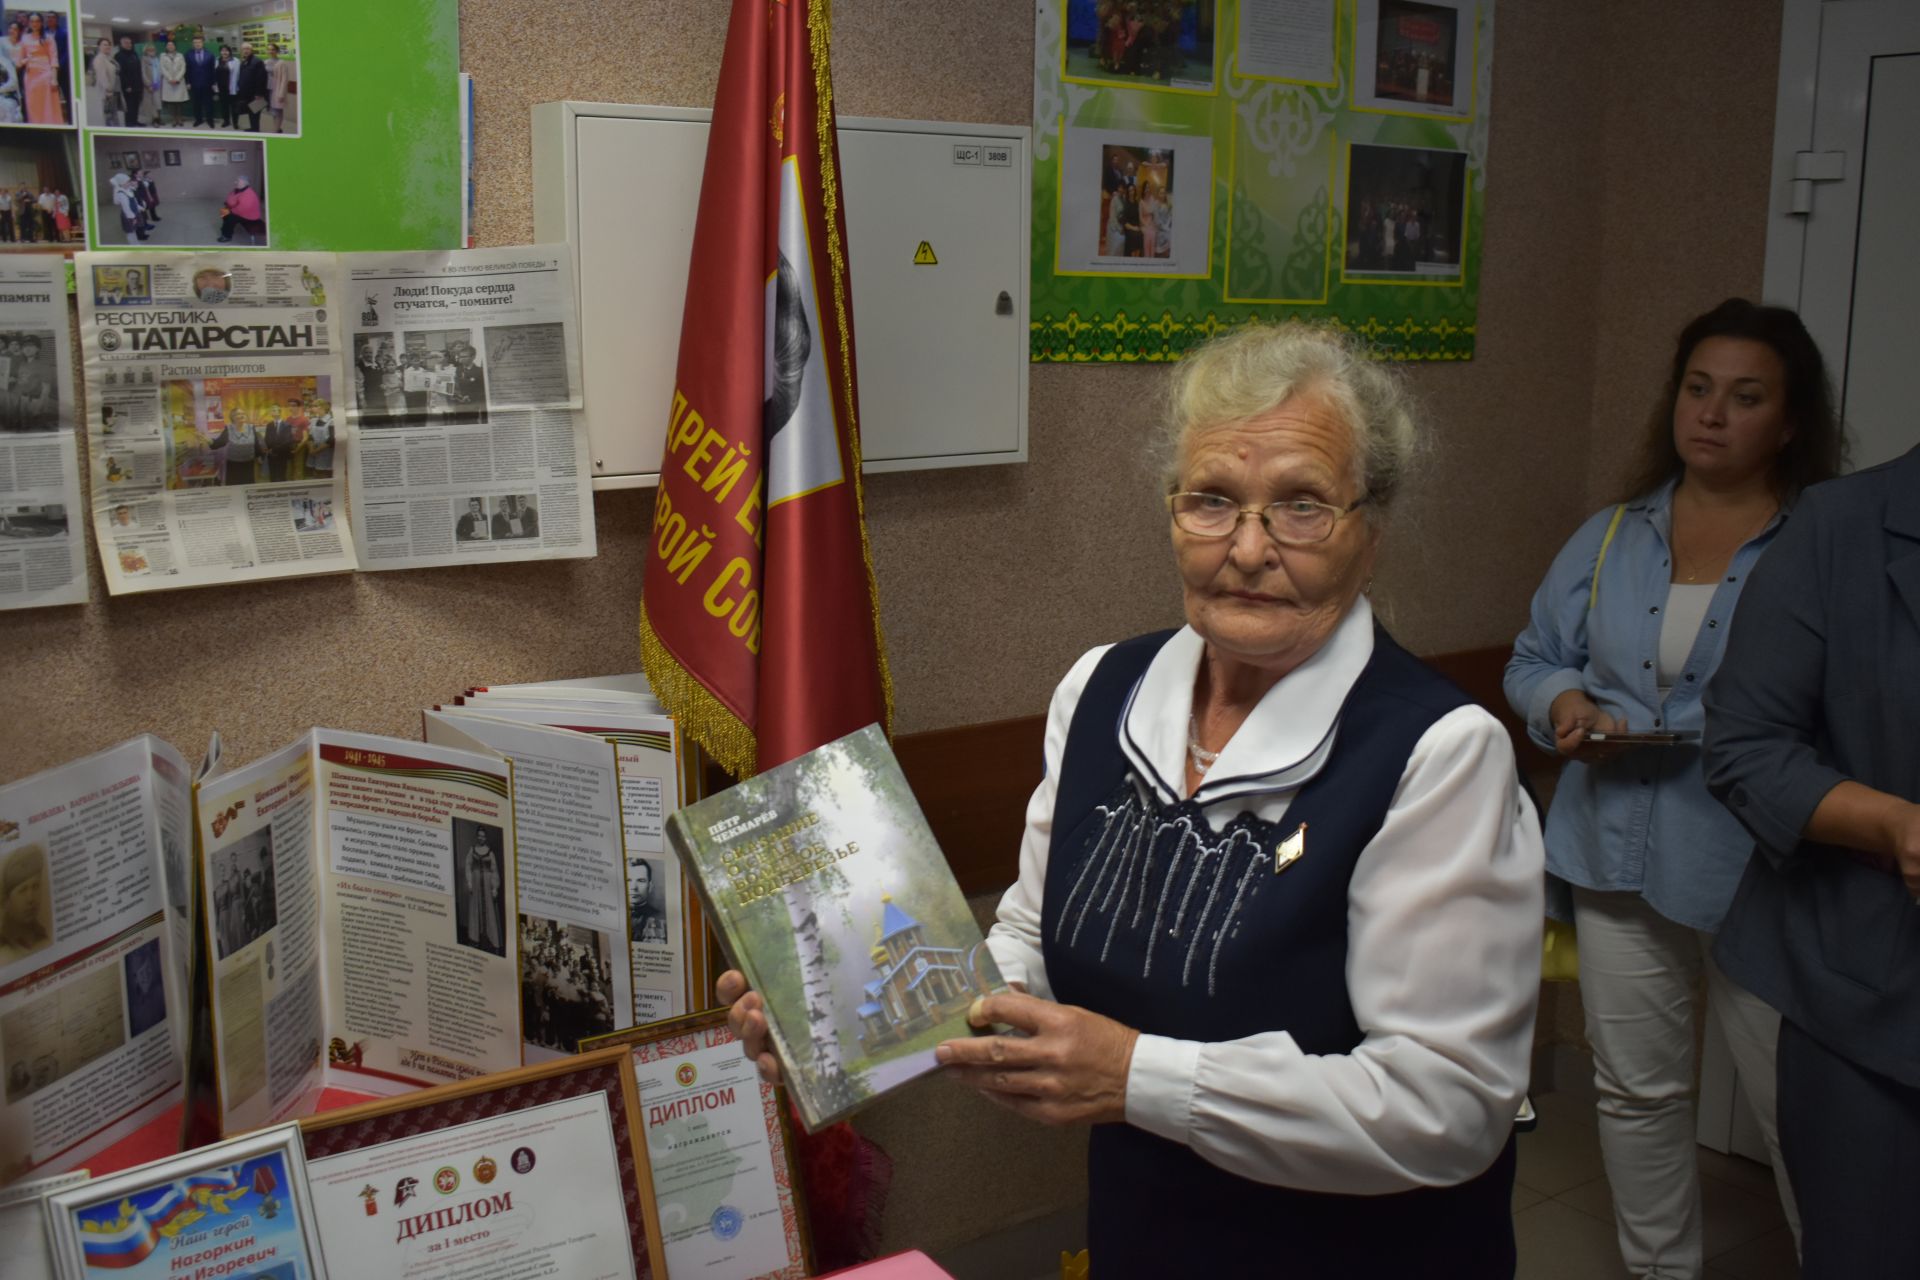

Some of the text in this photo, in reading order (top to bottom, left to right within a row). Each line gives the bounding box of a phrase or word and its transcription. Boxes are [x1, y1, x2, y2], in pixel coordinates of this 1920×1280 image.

[956, 150, 979, 160] ЩС-1
[484, 262, 517, 272] ВЕЛИКОЙ
[518, 261, 546, 269] ПОБЕДЫ
[0, 294, 50, 303] памяти
[393, 282, 515, 297] Люди! Покуда сердца
[393, 299, 449, 311] стучатся,
[459, 295, 513, 307] помните!
[95, 310, 218, 325] РЕСПУБЛИКА
[123, 324, 313, 351] ТАТАРСТАН
[160, 362, 266, 376] Растим патриотов
[708, 815, 741, 836] ПЁТР
[712, 809, 778, 844] ЧЕКМАРЁВ
[720, 812, 820, 865] СКАЗАНИЕ
[649, 1087, 736, 1129] ДИПЛОМ
[668, 1129, 732, 1150] награждается
[396, 1192, 514, 1244] ДИПЛОМ
[170, 1215, 250, 1250] Наш герой
[427, 1244, 443, 1253] за
[453, 1230, 491, 1246] место
[171, 1235, 255, 1271] Нагоркин
[194, 1247, 277, 1280] Игоревич
